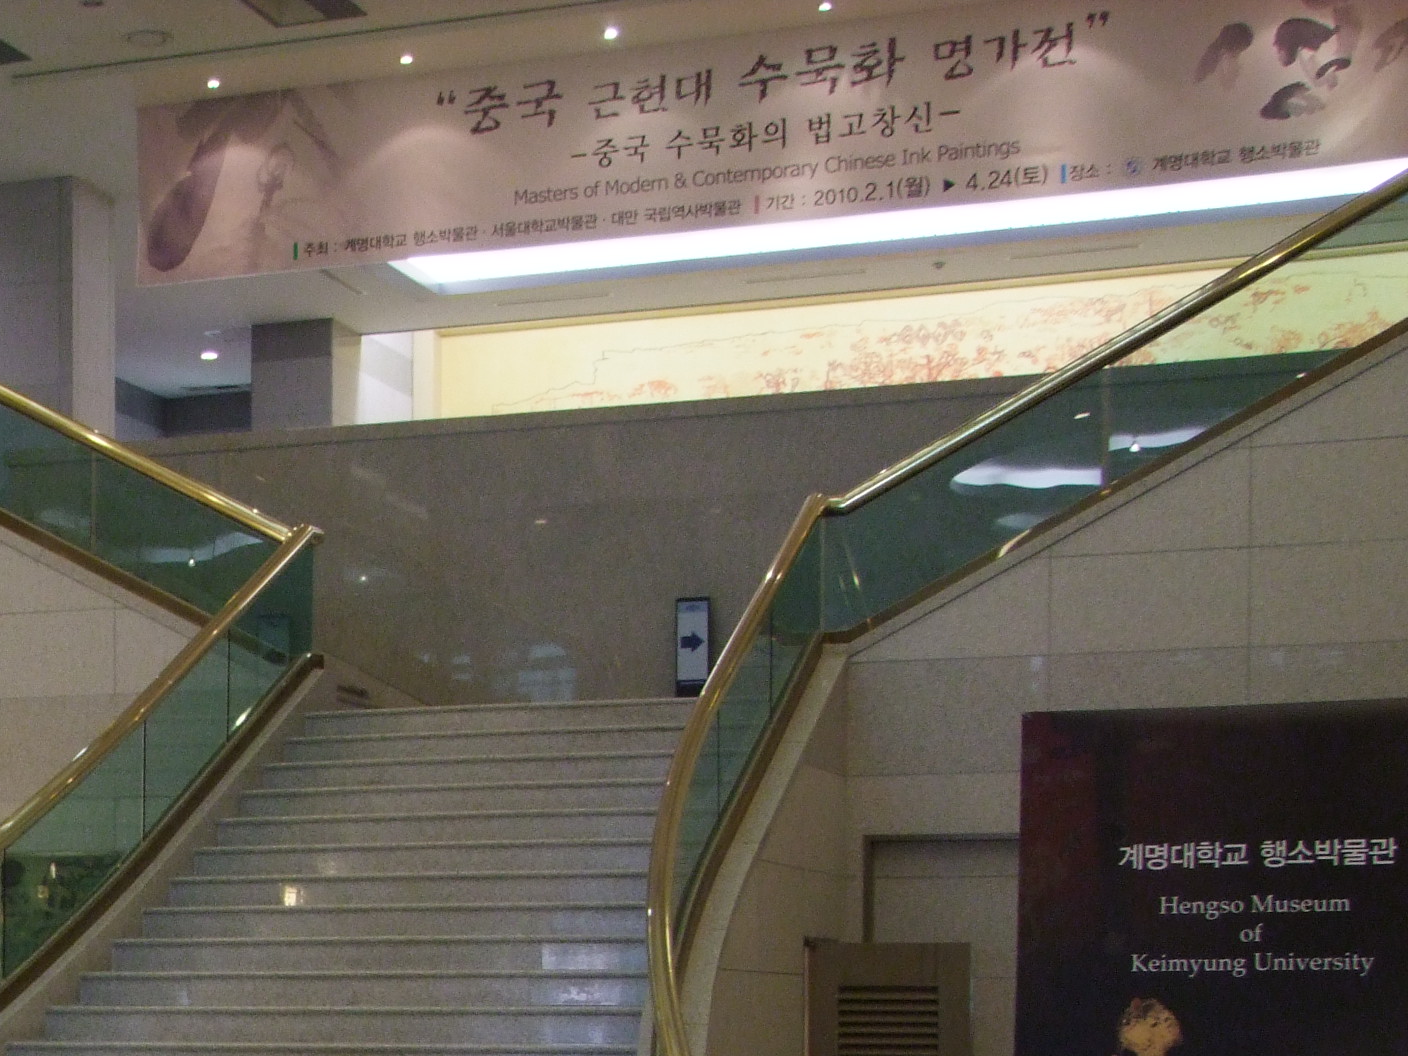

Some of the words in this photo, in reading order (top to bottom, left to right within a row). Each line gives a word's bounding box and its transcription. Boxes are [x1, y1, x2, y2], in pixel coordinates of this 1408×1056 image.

[588, 69, 713, 120] 근현대
[738, 37, 905, 103] 수묵화
[571, 135, 650, 169] -중국
[665, 118, 787, 160] 수묵화의
[513, 187, 578, 205] Masters
[584, 182, 601, 198] of
[605, 177, 668, 196] Modern
[674, 172, 687, 189] &
[693, 160, 818, 187] Contemporary
[825, 149, 895, 172] Chinese
[902, 146, 931, 165] Ink
[937, 137, 1021, 162] Paintings
[345, 234, 407, 253] 계명대학교
[413, 226, 478, 247] 행소박물관
[492, 213, 597, 238] 서울대학교박물관
[611, 210, 638, 226] 대만
[644, 199, 742, 223] 국립역사박물관
[814, 176, 931, 207] 2010.2.1(월)
[966, 163, 1049, 191] 4.24(토)
[1152, 150, 1231, 172] 계명대학교
[1239, 139, 1321, 165] 행소박물관
[1118, 841, 1249, 871] 계명대학교
[1260, 837, 1399, 868] 행소박물관
[1159, 896, 1243, 920] Hengso
[1251, 895, 1351, 914] Museum
[1239, 923, 1264, 942] of
[1130, 953, 1247, 978] Keimyung
[1254, 952, 1375, 977] University
